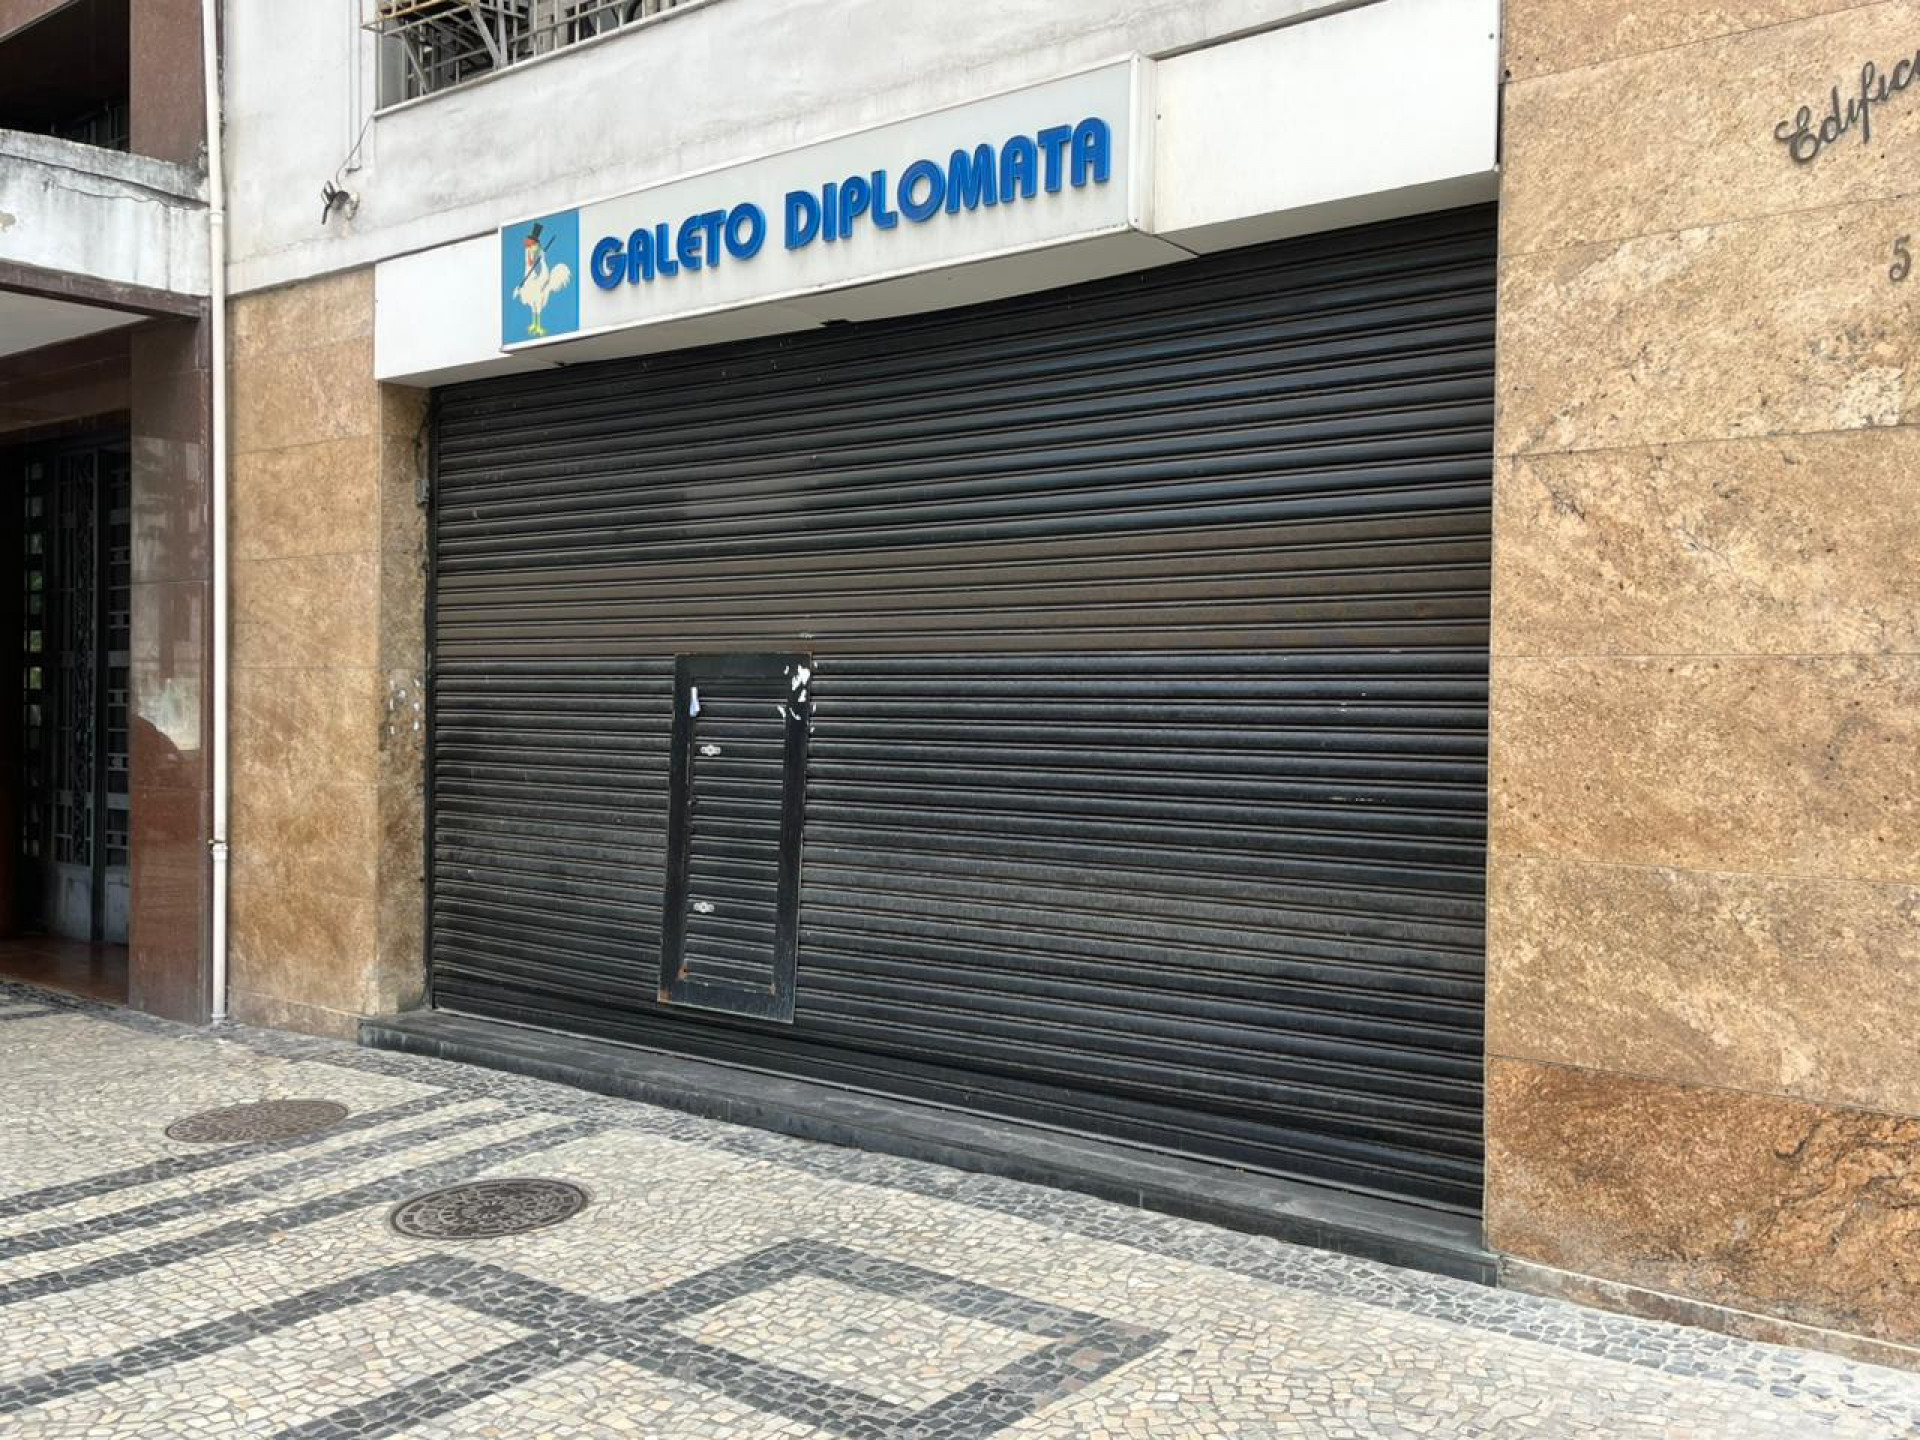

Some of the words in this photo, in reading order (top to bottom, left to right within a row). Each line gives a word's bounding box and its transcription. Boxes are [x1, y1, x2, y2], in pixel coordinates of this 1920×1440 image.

[591, 203, 765, 290] GALETO
[785, 117, 1111, 250] DIPLOMATA
[1889, 234, 1911, 282] 5
